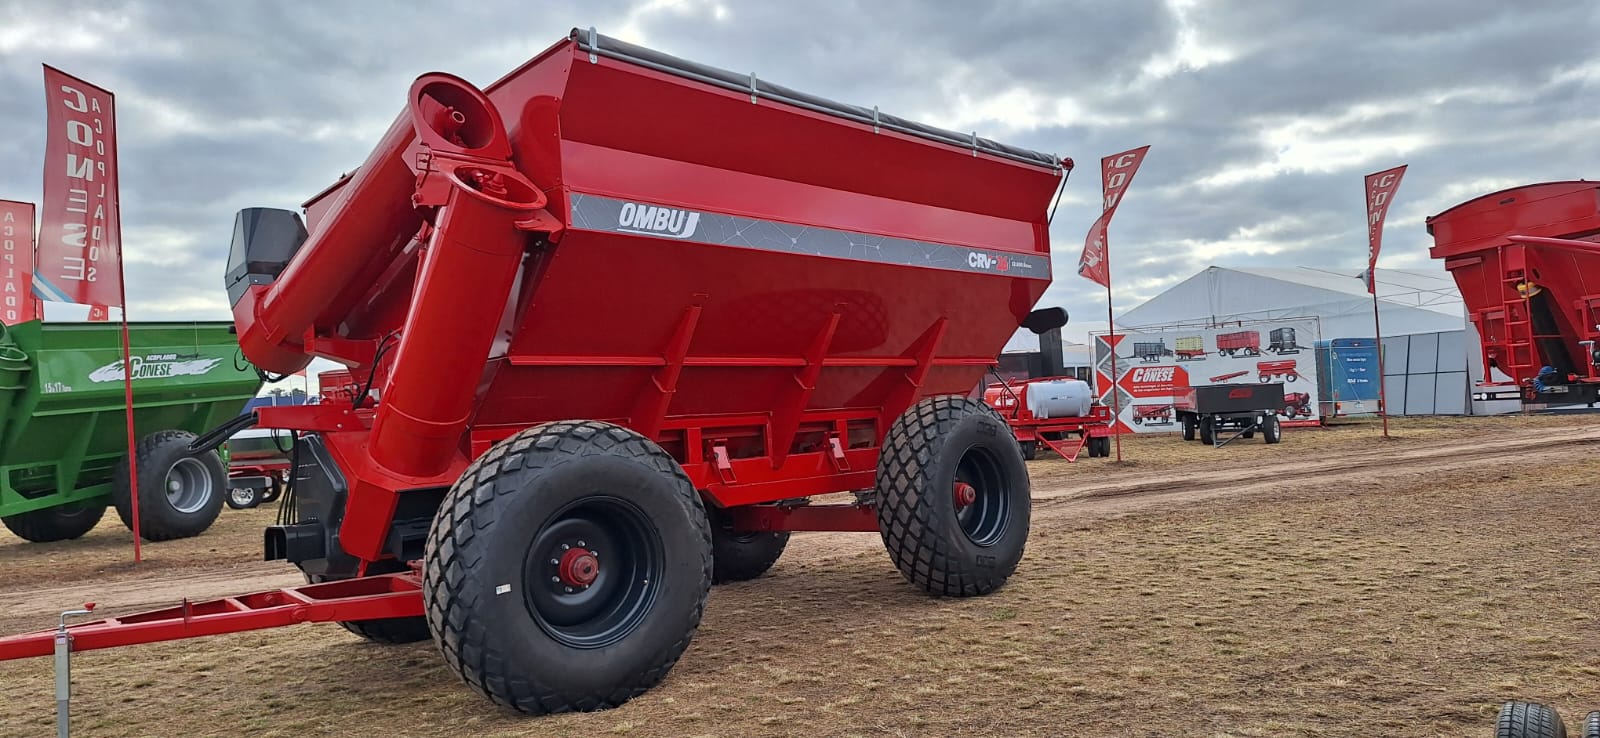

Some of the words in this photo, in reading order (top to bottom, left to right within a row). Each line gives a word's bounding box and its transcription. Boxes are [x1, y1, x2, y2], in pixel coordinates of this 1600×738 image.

[1104, 154, 1136, 211] CON
[619, 203, 685, 233] OMBU
[130, 357, 172, 378] CONESE
[1133, 368, 1174, 382] CONESE
